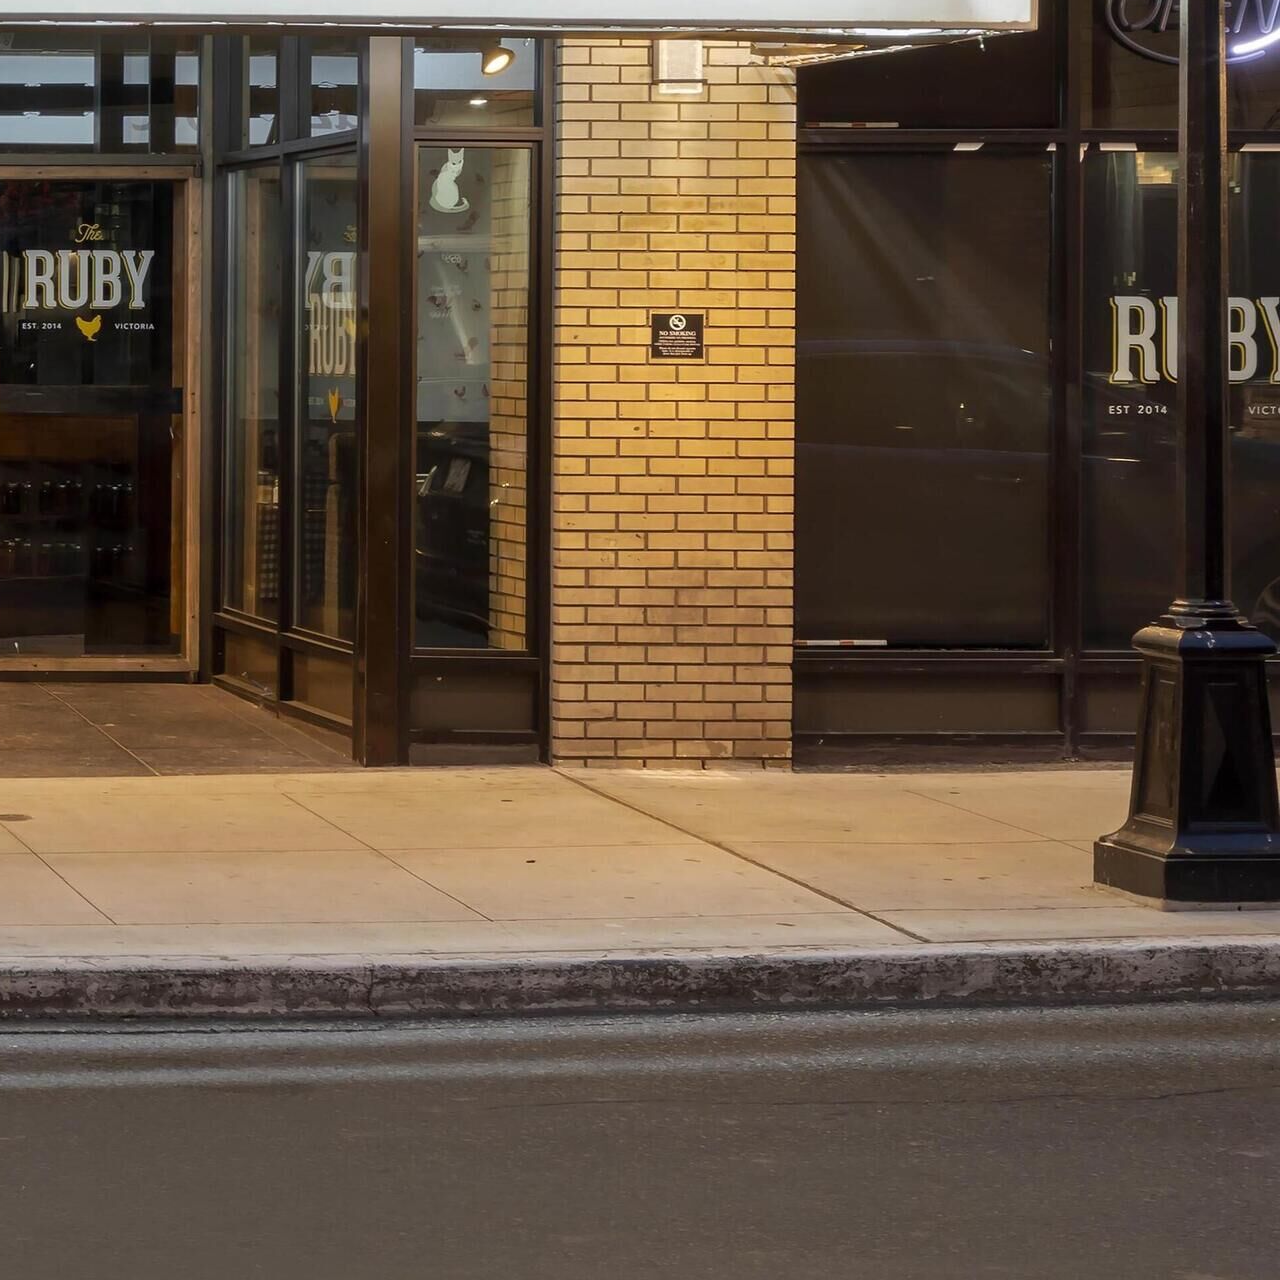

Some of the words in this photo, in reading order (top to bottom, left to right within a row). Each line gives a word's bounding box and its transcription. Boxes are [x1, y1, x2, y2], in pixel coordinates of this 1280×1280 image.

[74, 223, 104, 243] The
[22, 249, 156, 310] RUBY
[42, 322, 62, 330] 2014
[114, 322, 155, 330] VICTORIA
[1109, 405, 1131, 415] EST
[1137, 405, 1168, 415] 2014
[1248, 405, 1280, 416] VICT
